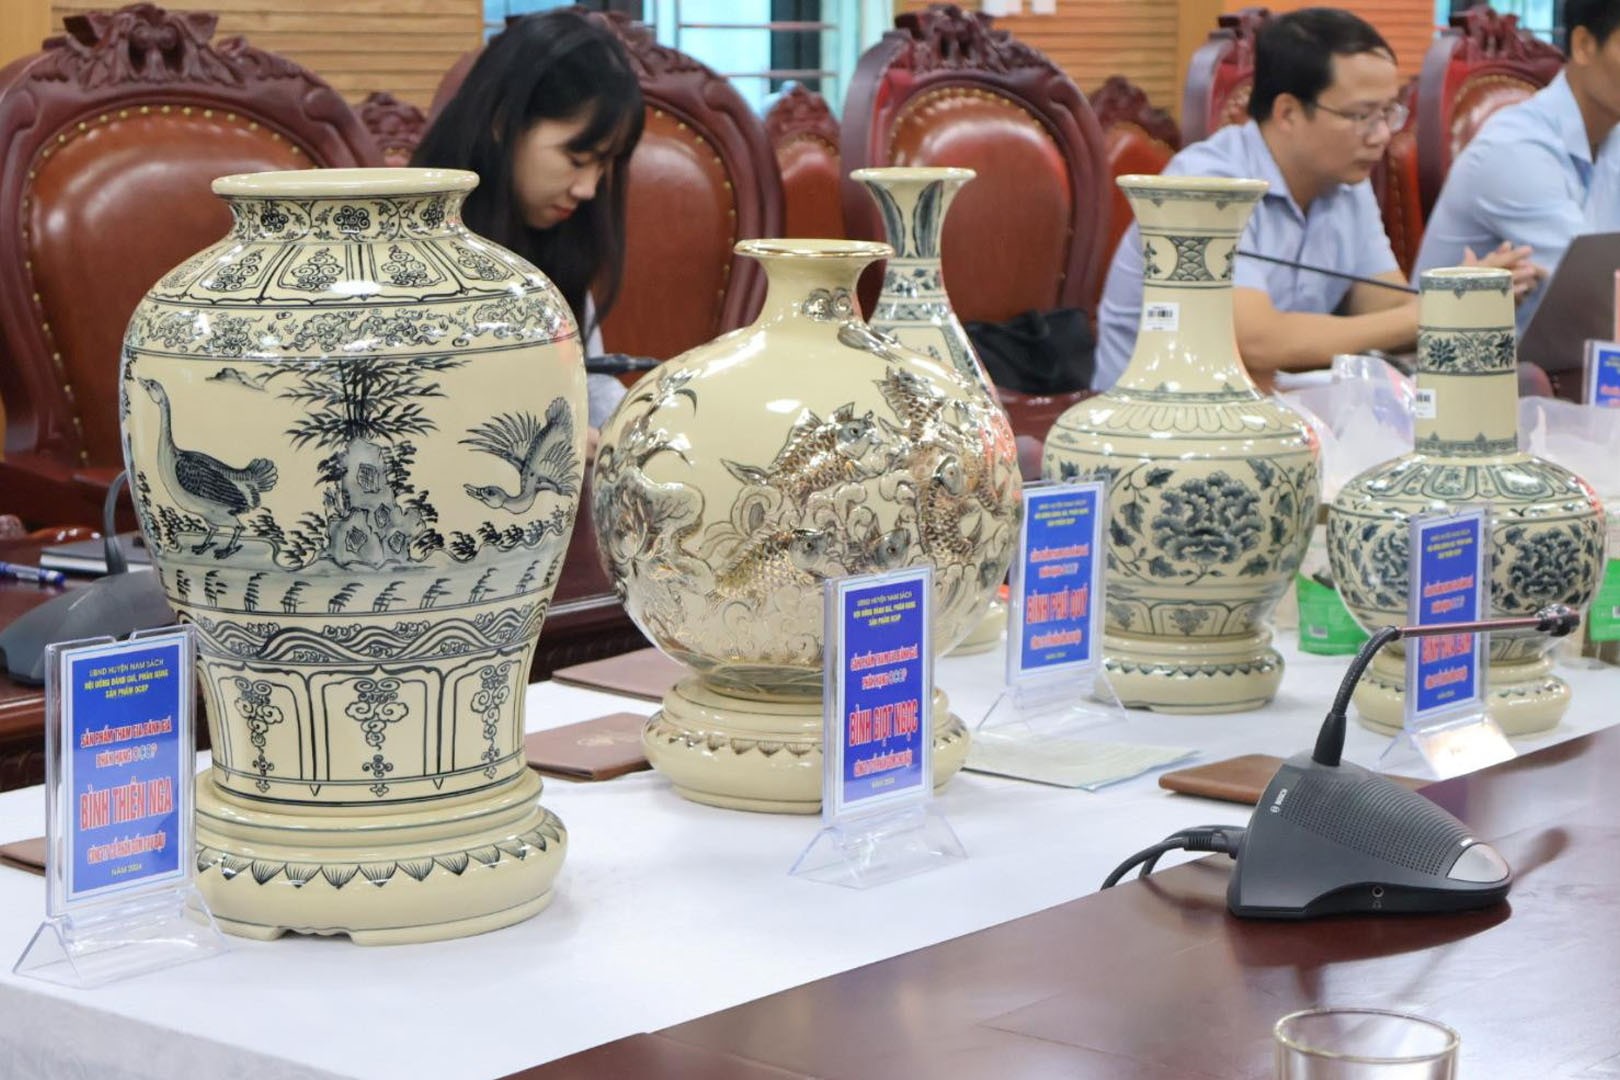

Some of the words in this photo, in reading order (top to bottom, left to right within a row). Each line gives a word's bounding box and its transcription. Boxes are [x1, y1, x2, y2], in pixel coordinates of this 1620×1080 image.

[849, 704, 871, 745] BÌNH
[873, 705, 893, 747] GIỌT
[80, 784, 109, 830] BÌNH
[111, 776, 145, 823] THIÊN
[147, 776, 172, 816] NGA
